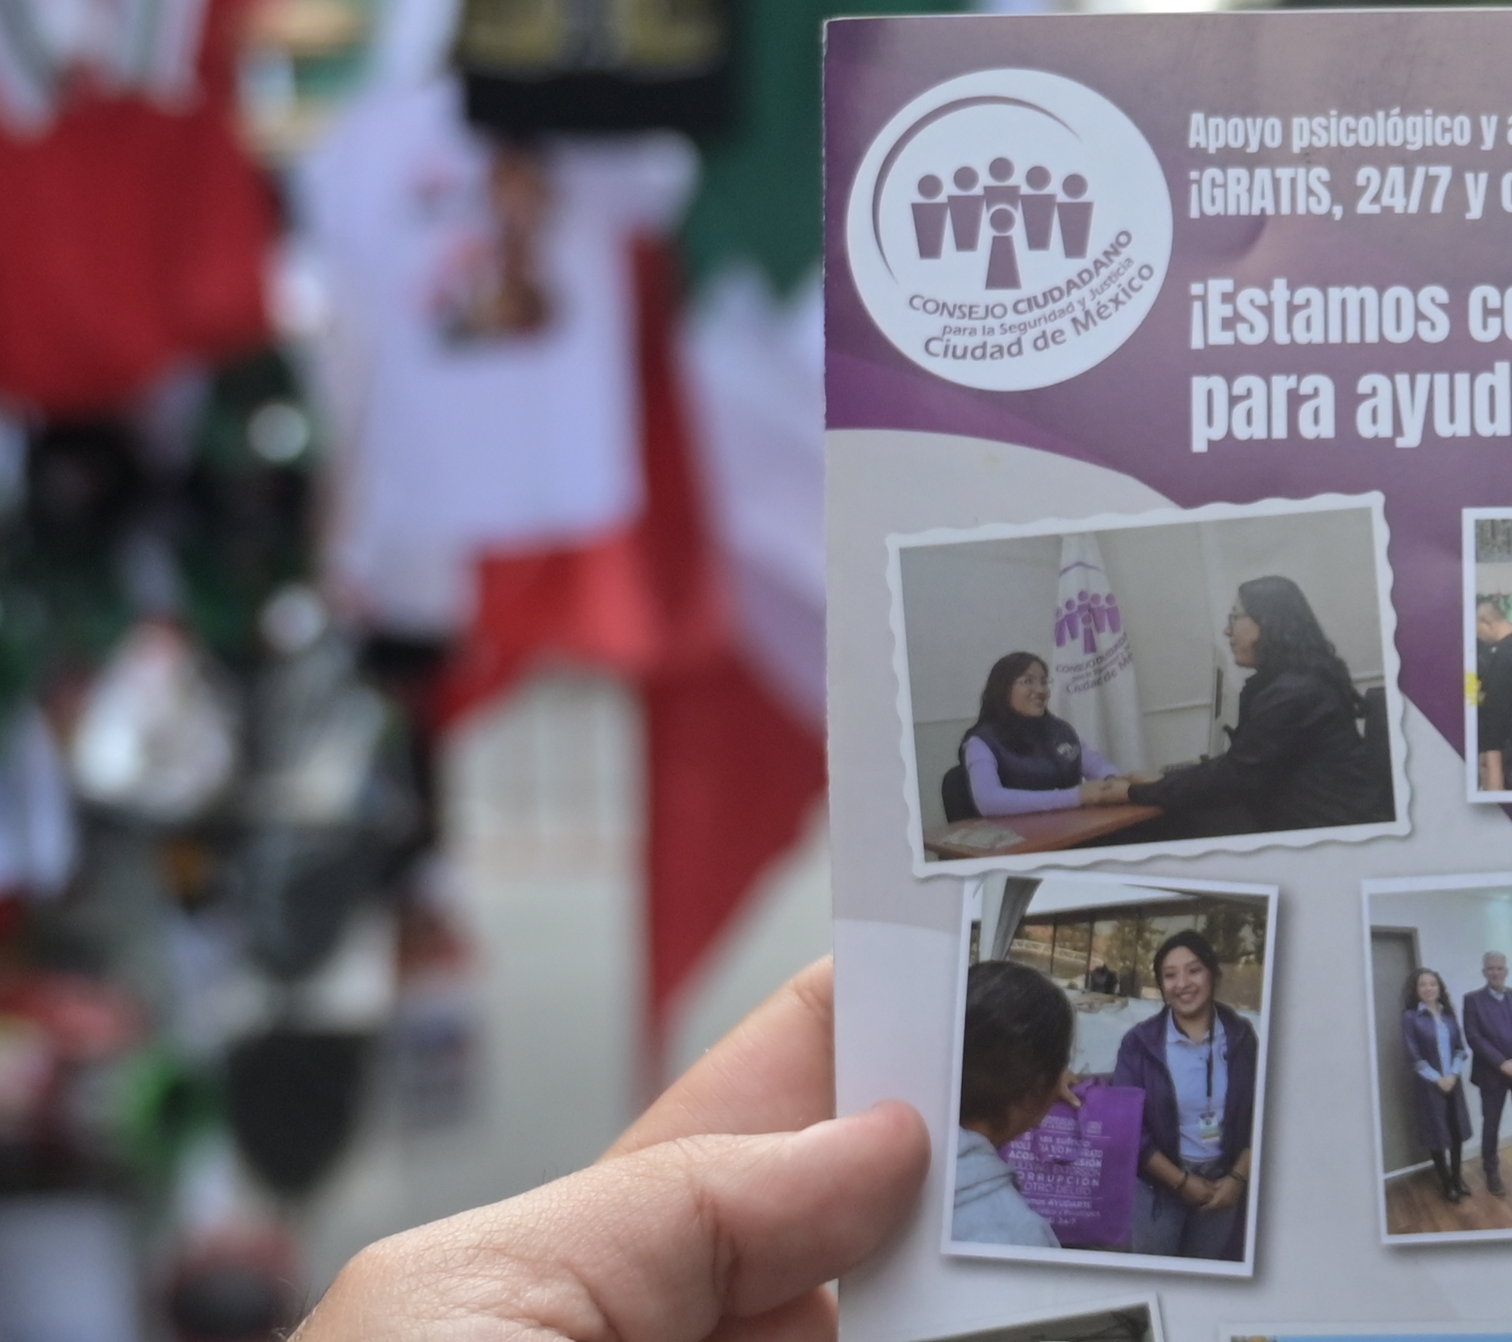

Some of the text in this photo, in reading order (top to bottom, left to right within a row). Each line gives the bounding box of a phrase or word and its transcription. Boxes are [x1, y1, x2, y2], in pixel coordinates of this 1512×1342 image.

[1188, 111, 1283, 154] Apoyo
[1291, 106, 1472, 154] psicológico
[1479, 114, 1499, 151] y
[1189, 165, 1344, 221] ¡GRATIS,
[1356, 165, 1452, 214] 24/7
[1464, 171, 1489, 220] y
[908, 229, 1133, 321] CONSEJO CIUDADANO
[924, 263, 1155, 361] Ciudad de México
[941, 256, 1135, 339] para la Seguridad y Justicia
[1189, 277, 1451, 350] ¡Estamos
[1191, 373, 1336, 453] para
